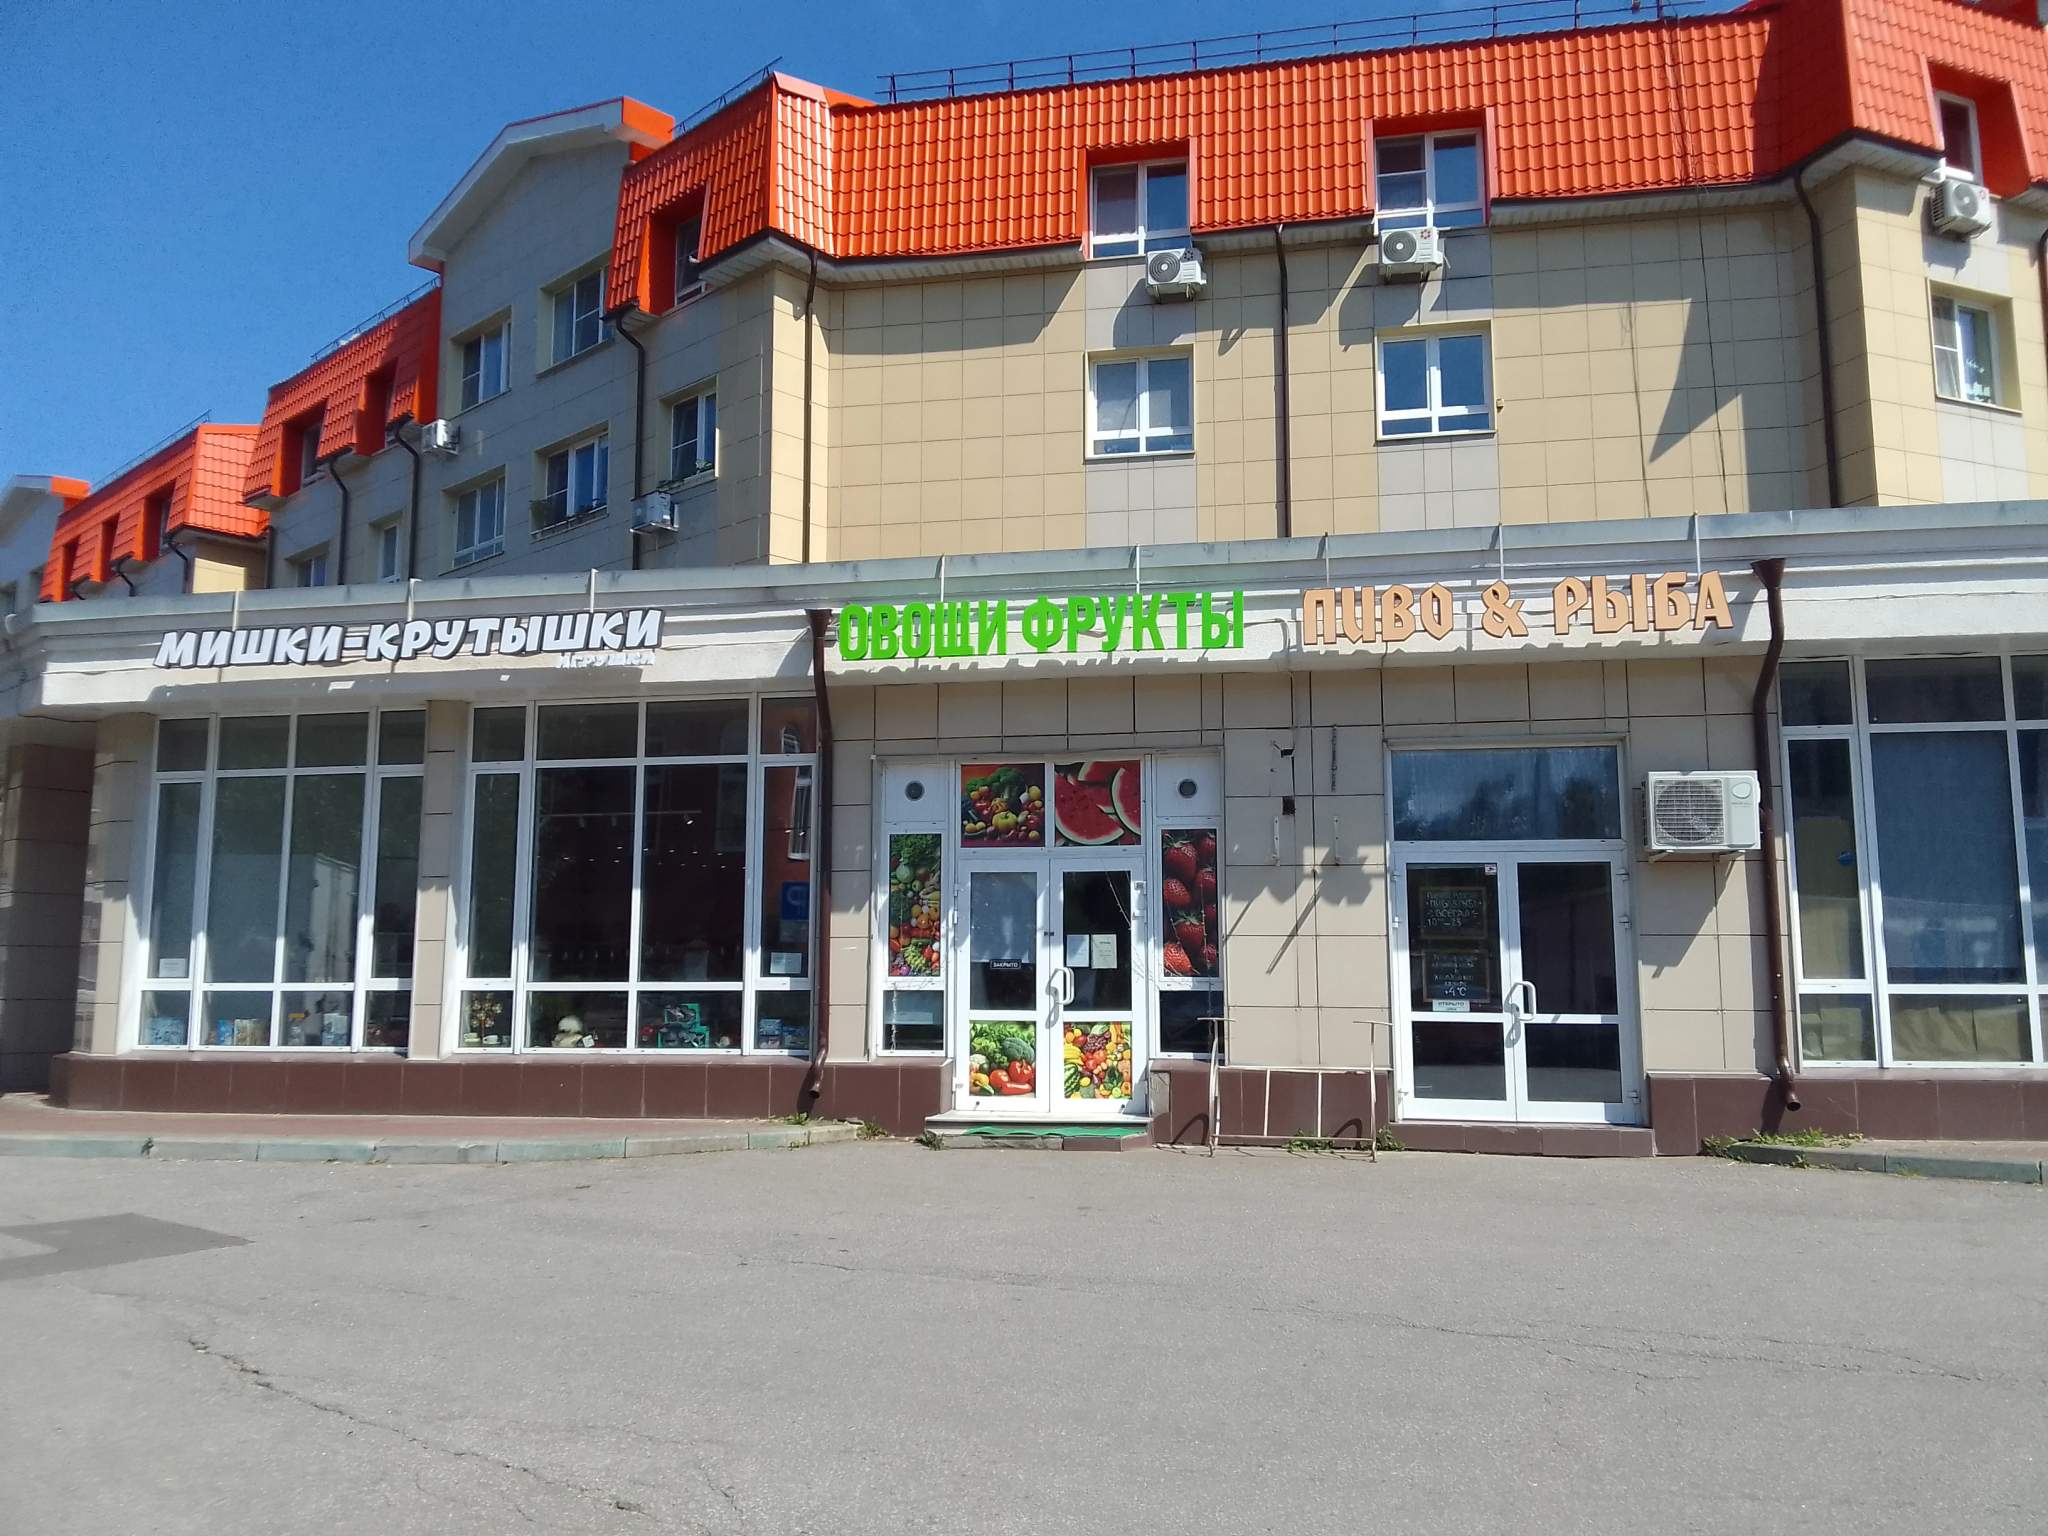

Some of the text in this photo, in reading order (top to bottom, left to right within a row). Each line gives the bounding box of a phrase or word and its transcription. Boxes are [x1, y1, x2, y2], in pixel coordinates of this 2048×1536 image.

[154, 608, 665, 669] МИШКИ-КРУТЫШКИ
[838, 590, 1244, 660] ОВОЩИ ФРУКТЫ
[1303, 570, 1734, 645] ПИВО & РЫБА
